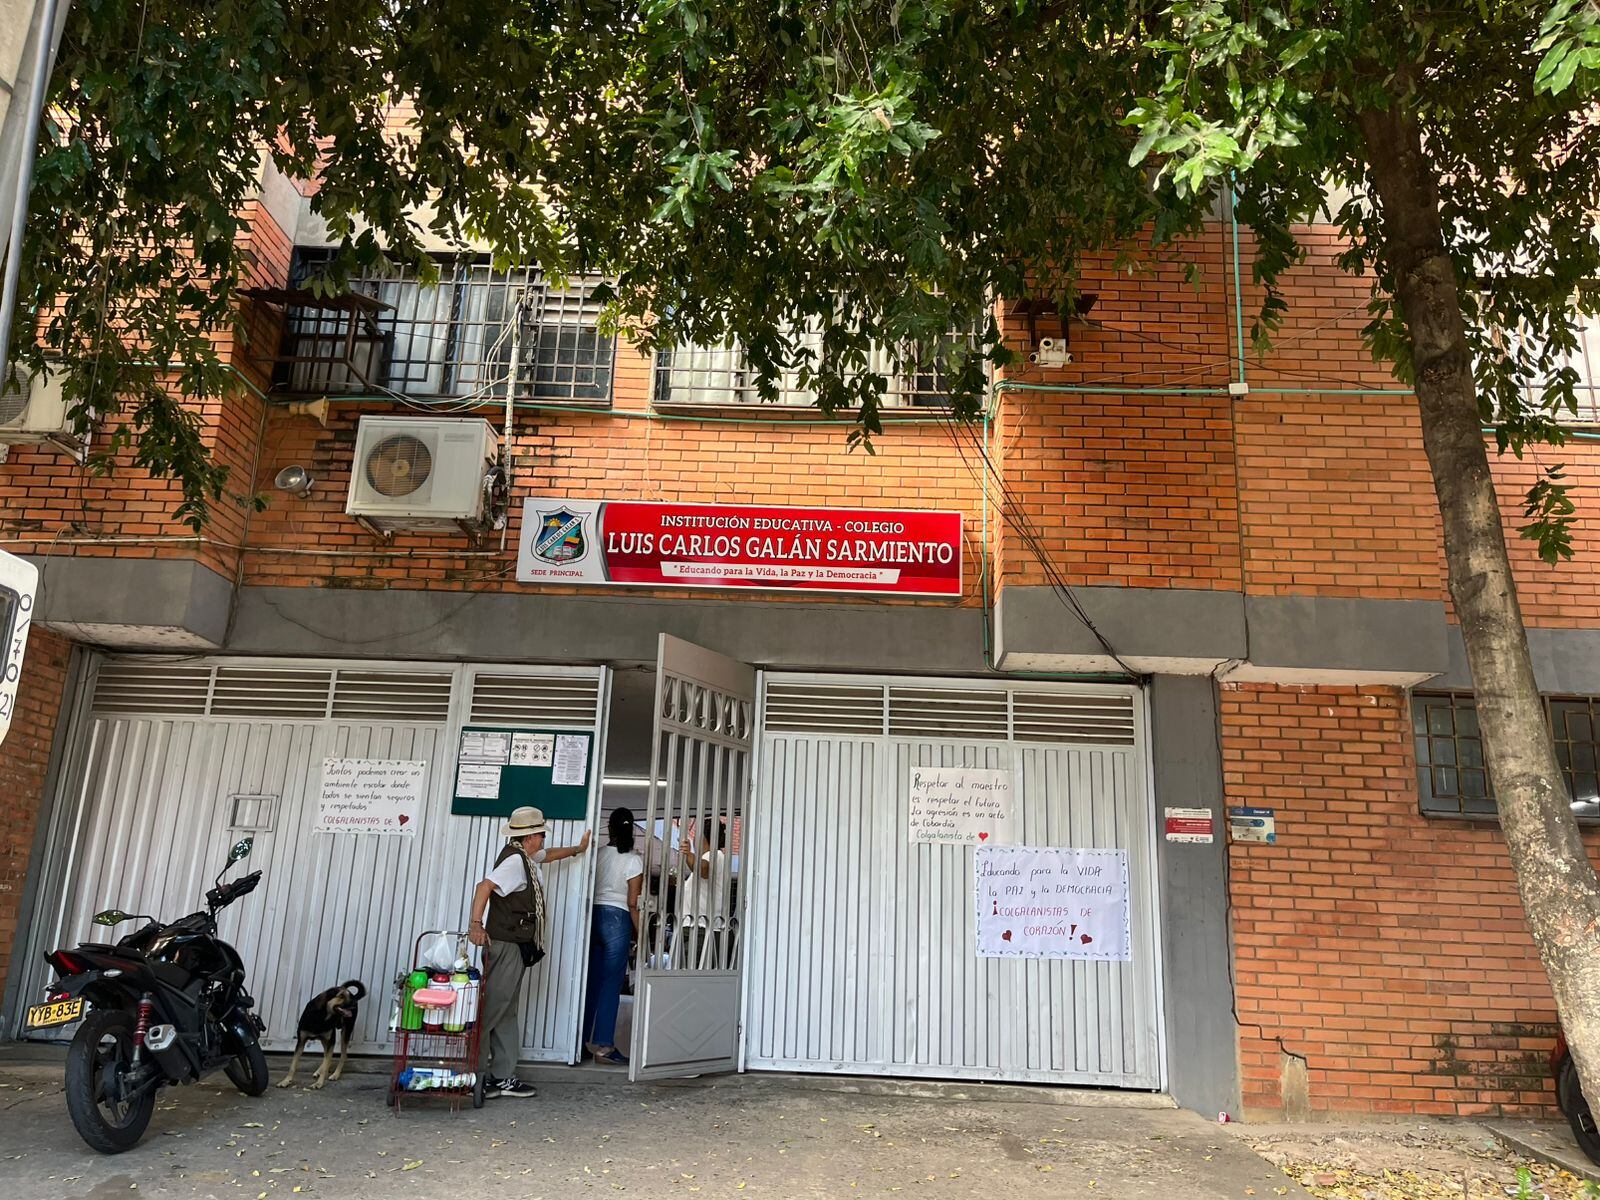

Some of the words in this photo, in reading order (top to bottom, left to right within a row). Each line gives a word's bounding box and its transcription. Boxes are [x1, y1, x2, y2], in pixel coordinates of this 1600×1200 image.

[660, 514, 750, 530] INSTITUCIÓN
[753, 518, 833, 532] EDUCATIVA
[844, 521, 905, 534] COLEGIO
[607, 532, 654, 555] LUIS
[658, 534, 741, 558] CARLOS
[745, 534, 822, 560] GALÁN
[826, 540, 953, 564] SARMIENTO
[723, 568, 743, 577] para
[745, 568, 754, 576] la
[755, 568, 779, 578] Vida,
[780, 569, 789, 577] la
[790, 569, 806, 577] Paz
[807, 572, 814, 580] y
[815, 570, 824, 578] la
[356, 767, 387, 779] podemos
[324, 779, 358, 788] ambiente
[390, 780, 411, 789] donde
[913, 772, 950, 794] Respetar
[955, 776, 965, 789] al
[971, 778, 1008, 791] maestro
[321, 790, 340, 799] todos
[356, 791, 382, 800] sientan
[386, 795, 415, 804] seguros
[927, 793, 960, 808] respetar
[963, 796, 972, 807] el
[320, 803, 326, 812] y
[926, 807, 958, 820] agresión
[988, 810, 1005, 819] acto
[384, 817, 393, 826] DE
[910, 818, 920, 827] de
[966, 832, 976, 841] de
[980, 860, 1021, 877] Educando
[1030, 867, 1051, 882] para
[1060, 864, 1069, 875] la
[1077, 865, 1103, 877] VIDA
[988, 886, 997, 897] la
[1005, 886, 1024, 896] PAZ
[1031, 889, 1036, 898] y
[1041, 885, 1049, 894] la
[1055, 884, 1113, 896] DEMOCRACIA
[1080, 907, 1093, 917] DE
[31, 1006, 52, 1024] YYB
[56, 1000, 80, 1018] 83E
